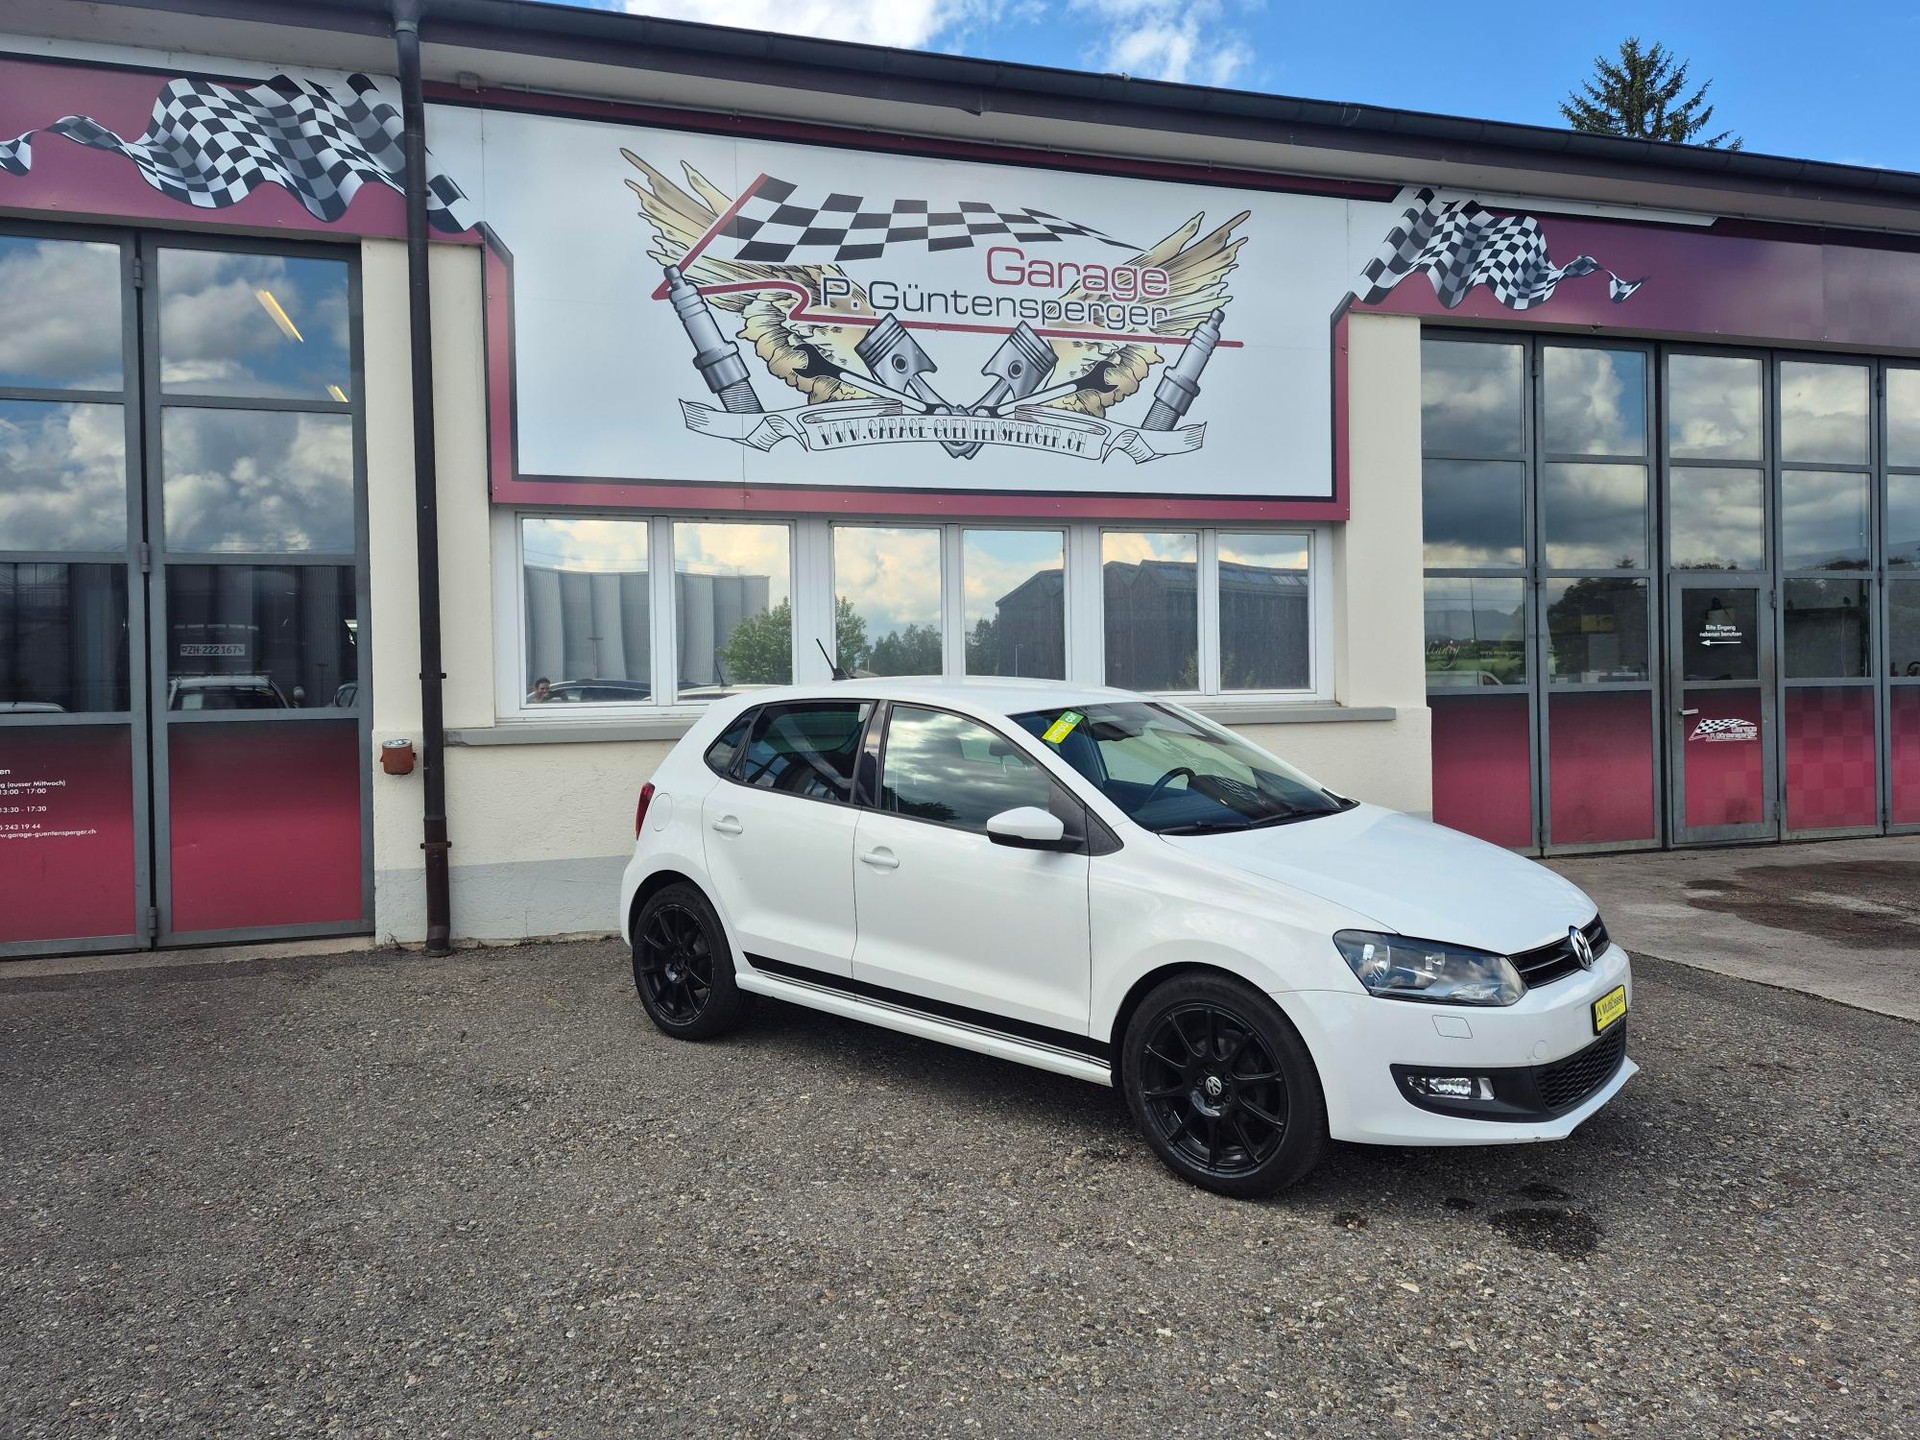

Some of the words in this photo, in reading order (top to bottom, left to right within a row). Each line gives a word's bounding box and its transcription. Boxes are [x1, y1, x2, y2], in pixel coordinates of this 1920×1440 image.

[986, 246, 1169, 301] Garage
[868, 280, 1169, 330] Güntensperger
[818, 417, 1088, 453] WWW.GARAGE-GUENTENSPERGER.CH
